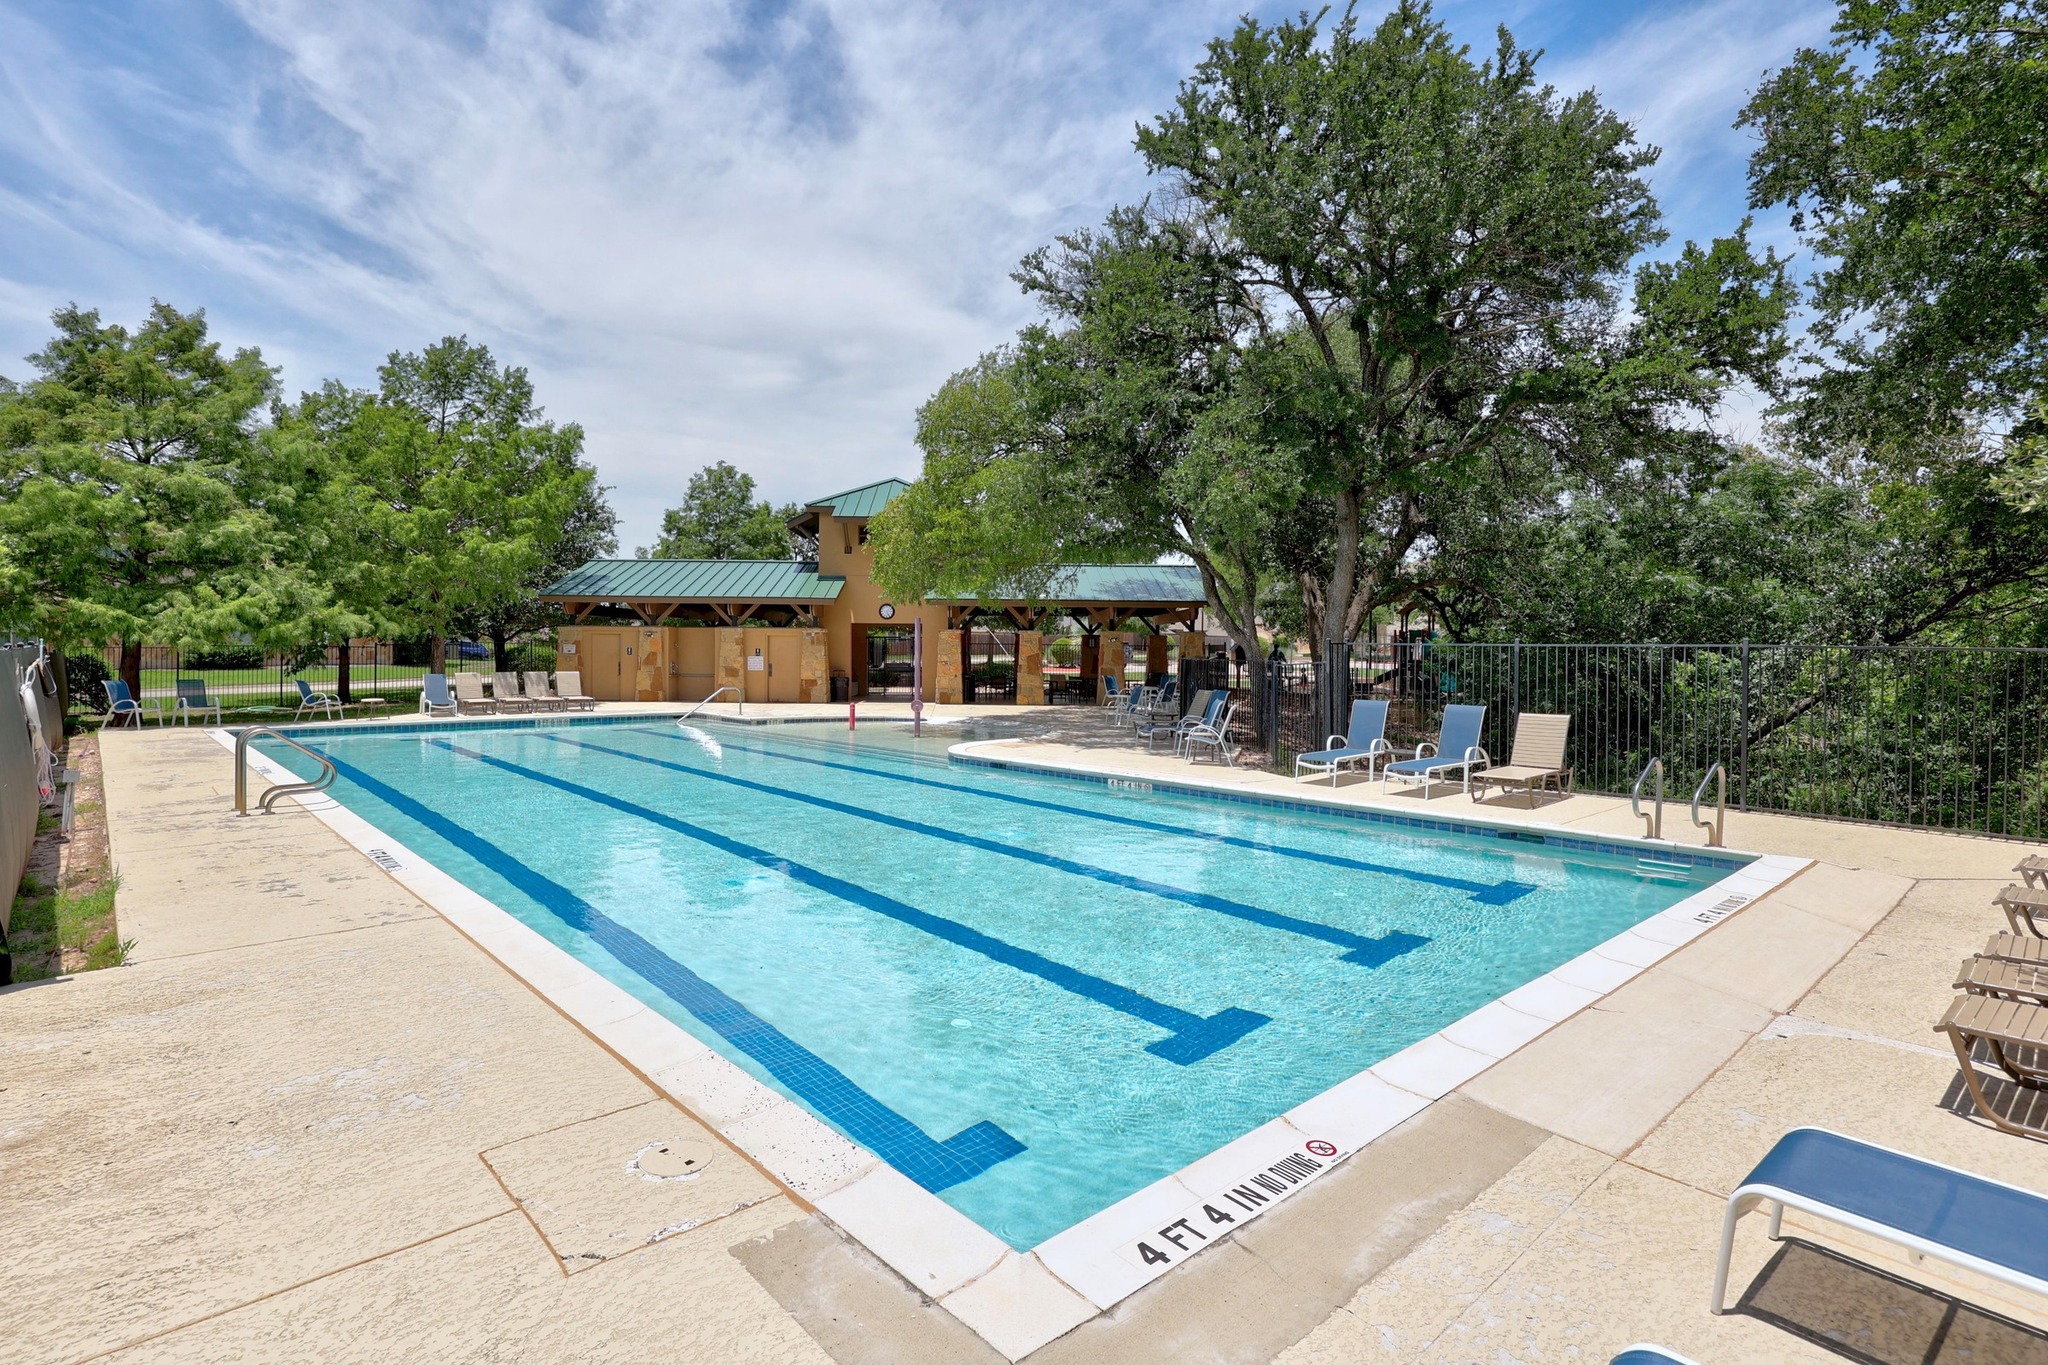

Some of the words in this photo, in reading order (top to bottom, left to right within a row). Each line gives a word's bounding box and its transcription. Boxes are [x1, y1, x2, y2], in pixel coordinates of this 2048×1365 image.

[1267, 1152, 1324, 1186] DIVING
[1250, 1173, 1289, 1196] NO
[1223, 1184, 1270, 1213] IN
[1202, 1204, 1236, 1225] 4
[1157, 1217, 1208, 1252] FT
[1136, 1241, 1172, 1266] 4
